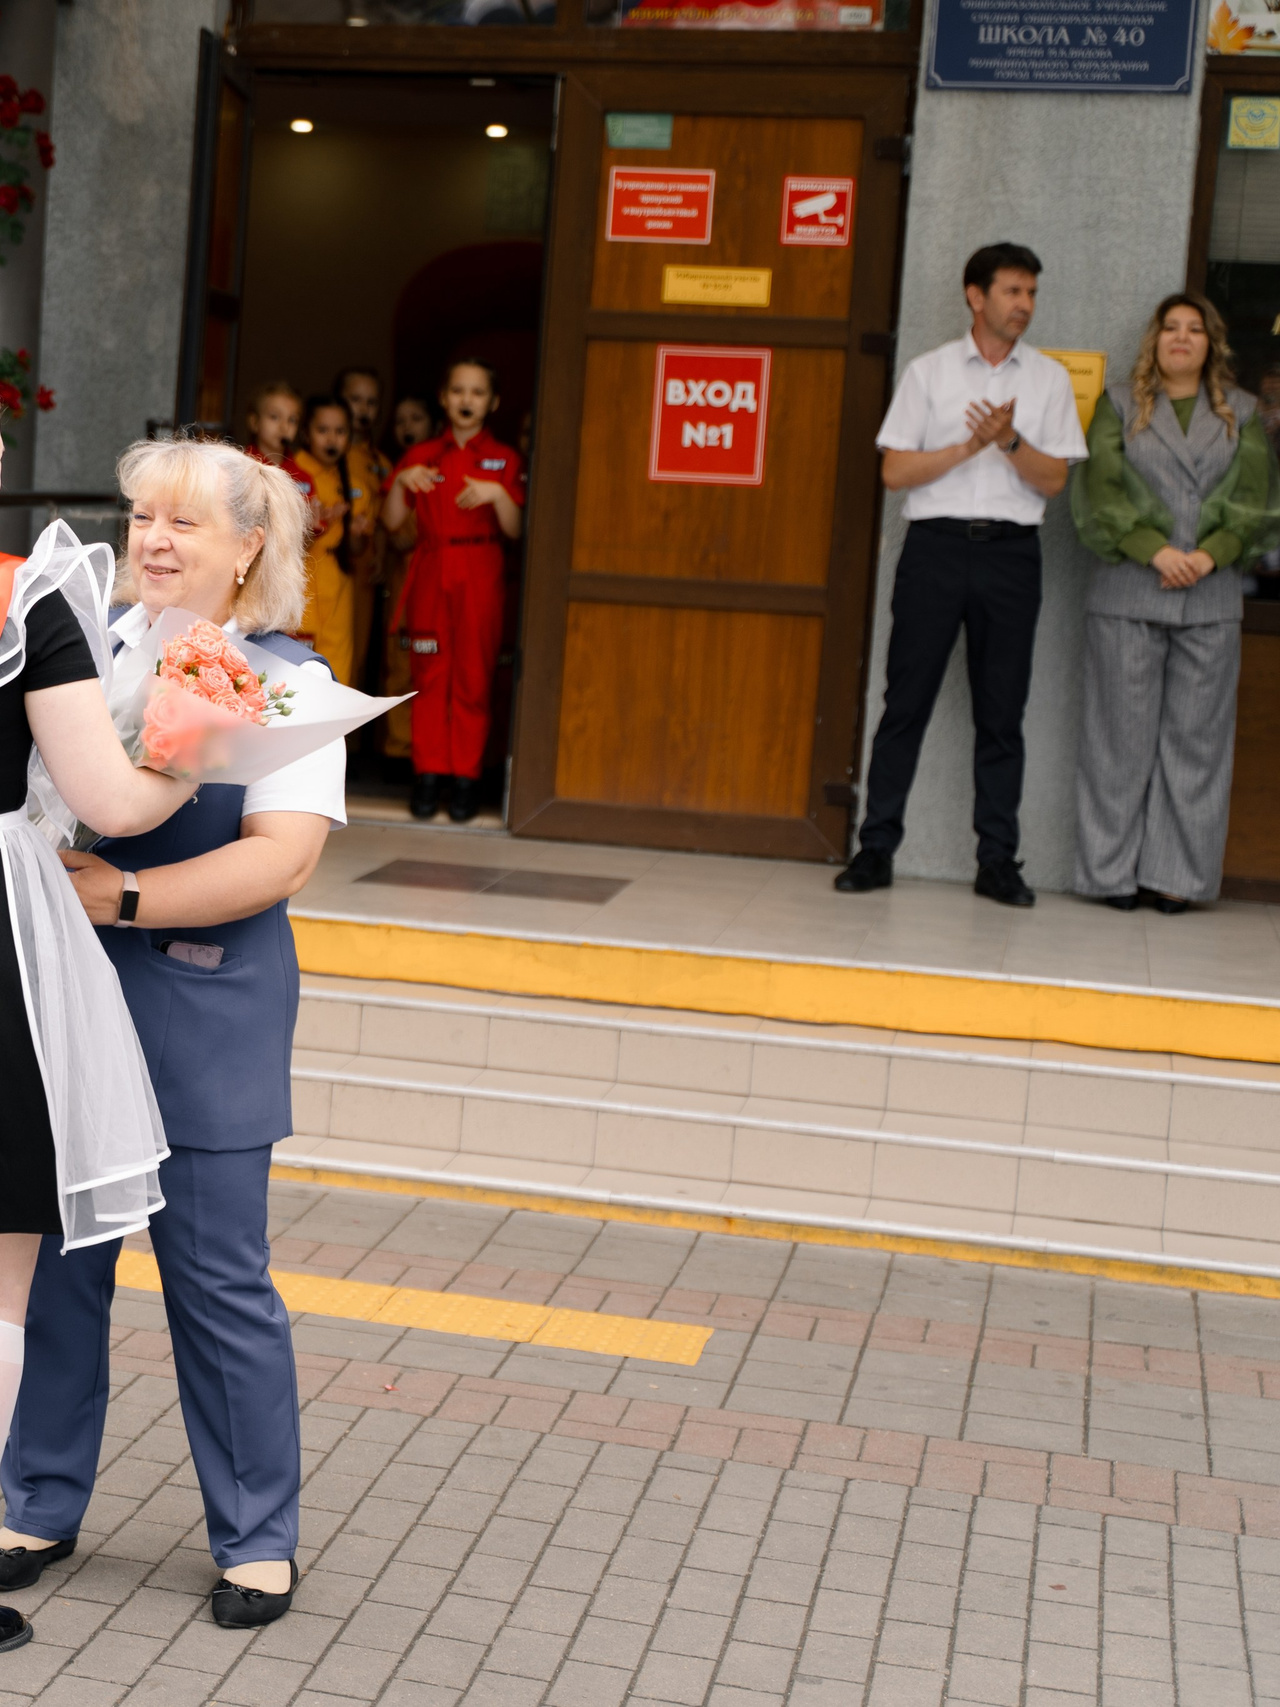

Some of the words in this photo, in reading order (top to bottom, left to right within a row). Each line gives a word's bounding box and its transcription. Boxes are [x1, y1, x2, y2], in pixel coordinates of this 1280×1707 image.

[978, 25, 1070, 45] ШКОЛА
[1081, 26, 1108, 46] №
[1112, 26, 1145, 47] 40
[665, 379, 757, 413] ВХОД
[681, 421, 734, 450] №1
